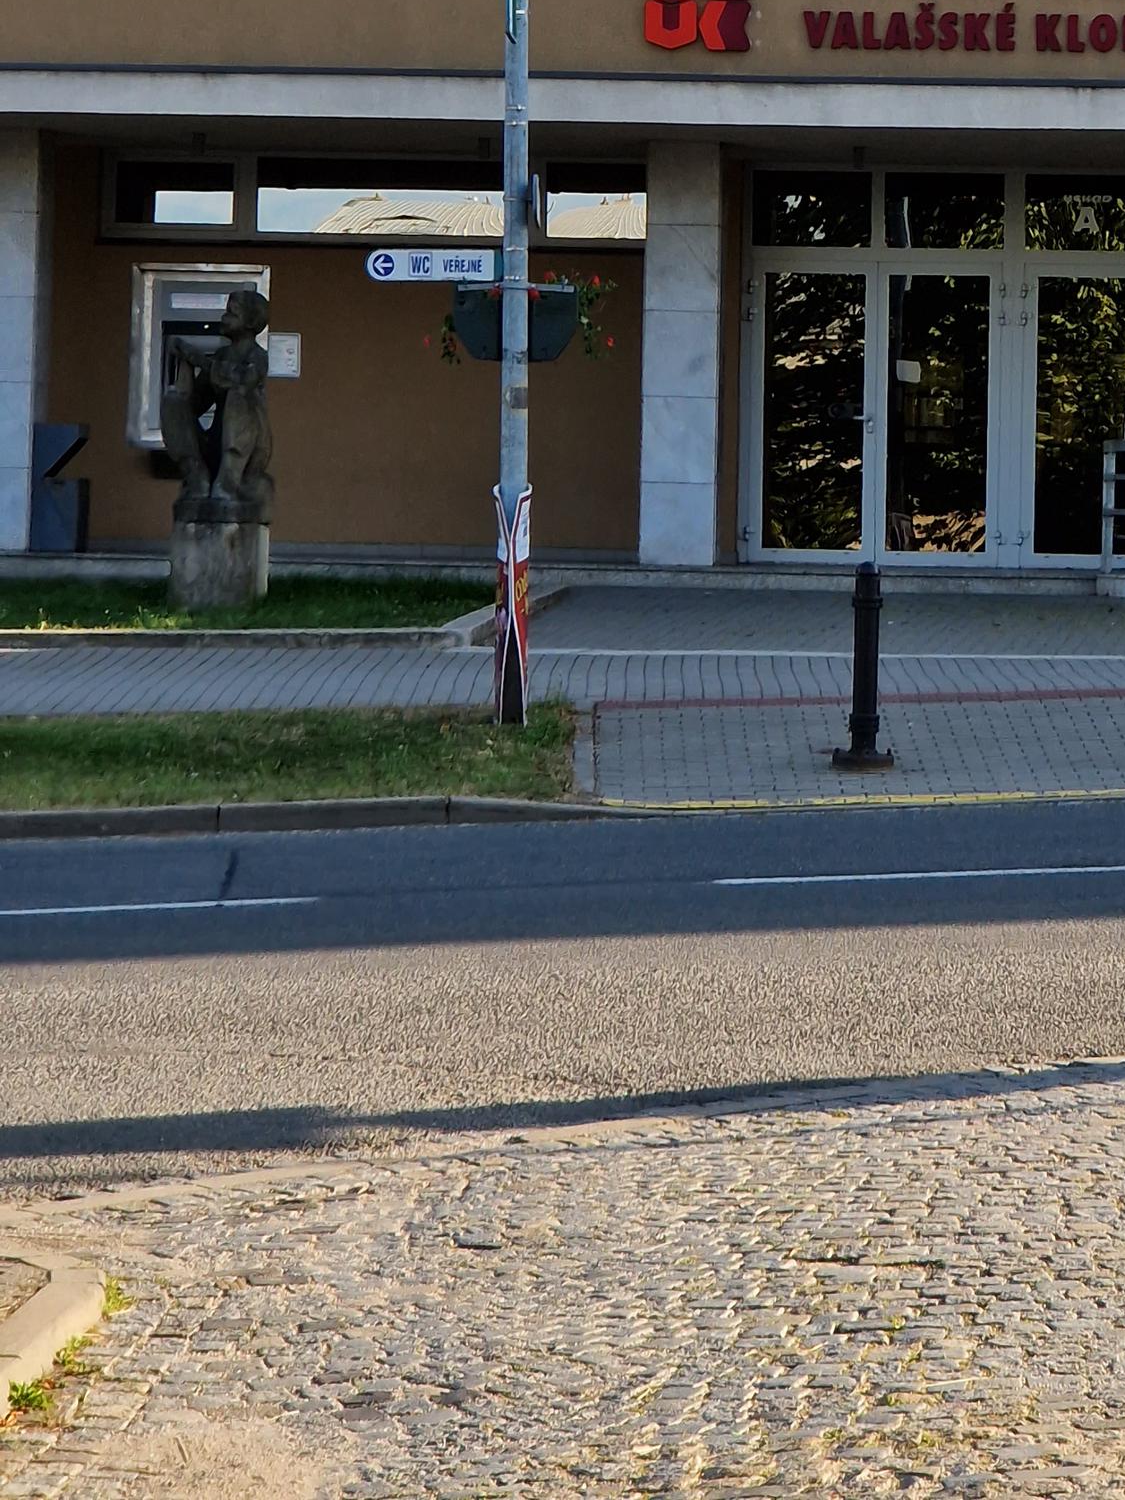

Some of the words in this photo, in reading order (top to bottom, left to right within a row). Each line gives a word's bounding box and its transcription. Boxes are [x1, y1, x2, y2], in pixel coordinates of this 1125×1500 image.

[803, 3, 1017, 53] VALAŠSKÉ
[1075, 207, 1100, 232] A
[411, 255, 430, 274] WC
[442, 255, 482, 274] VEŘEJNÉ
